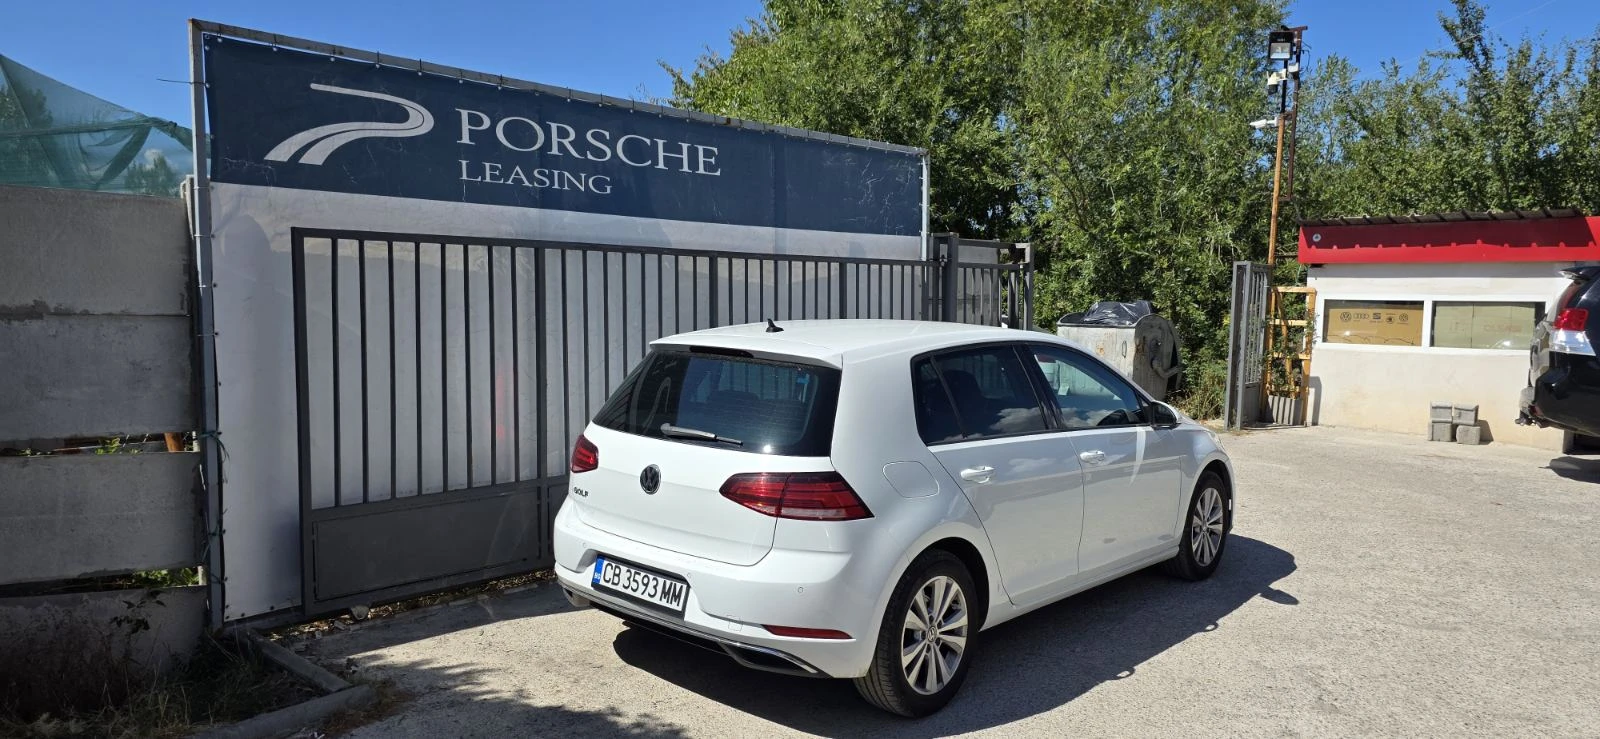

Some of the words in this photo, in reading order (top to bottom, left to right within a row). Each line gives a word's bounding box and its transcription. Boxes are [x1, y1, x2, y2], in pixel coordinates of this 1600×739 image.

[455, 108, 721, 176] PORSCHE
[458, 159, 612, 194] LEASING
[573, 486, 589, 497] GOLF
[603, 562, 621, 586] CB
[622, 569, 658, 598] 3593
[660, 580, 683, 606] MM
